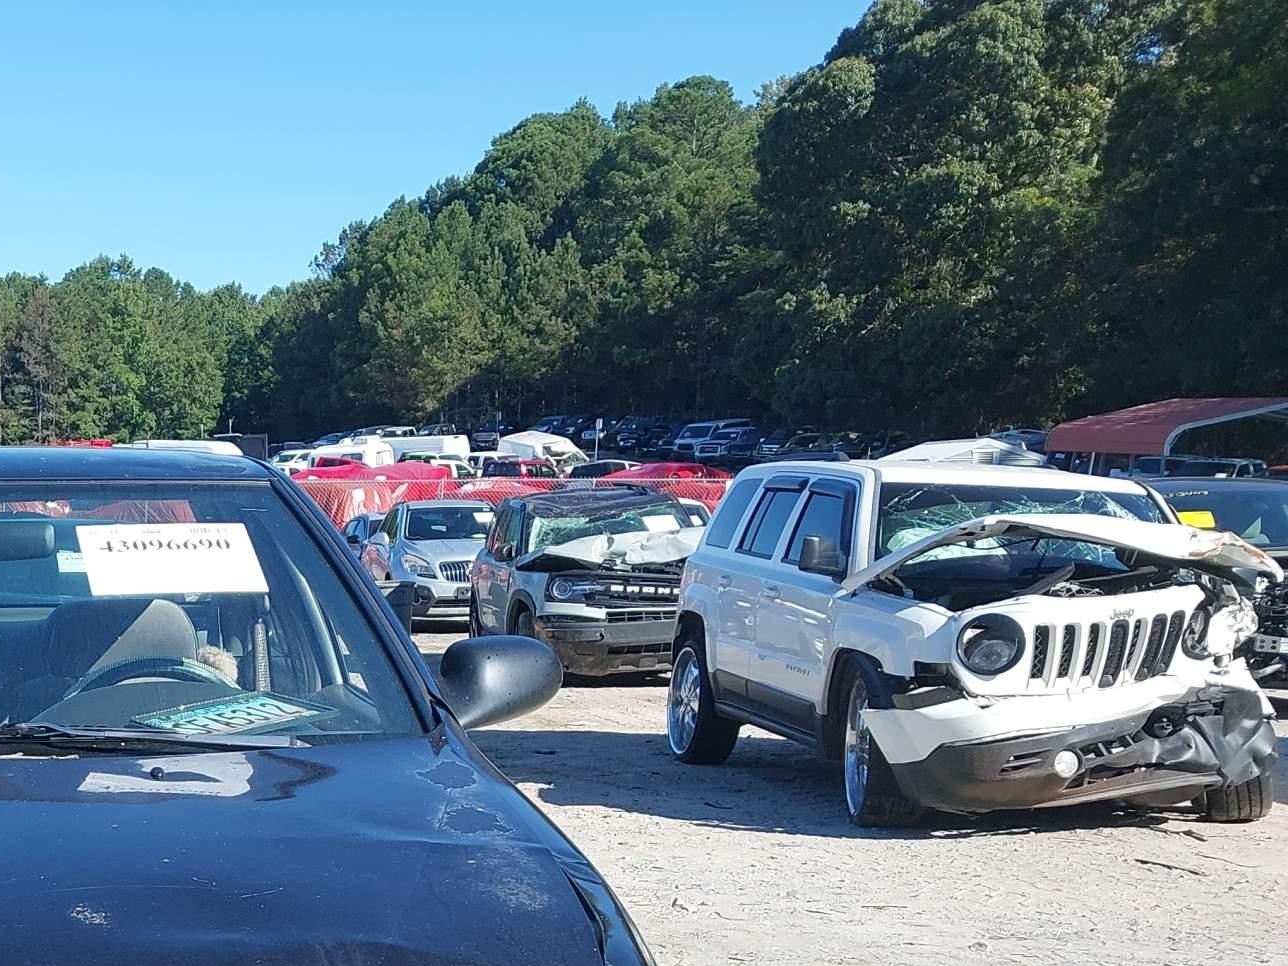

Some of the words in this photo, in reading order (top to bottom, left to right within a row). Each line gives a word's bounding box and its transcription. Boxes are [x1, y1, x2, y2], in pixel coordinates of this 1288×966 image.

[99, 538, 231, 553] 43096690
[610, 584, 681, 594] BRONC
[1109, 608, 1135, 621] Jeep
